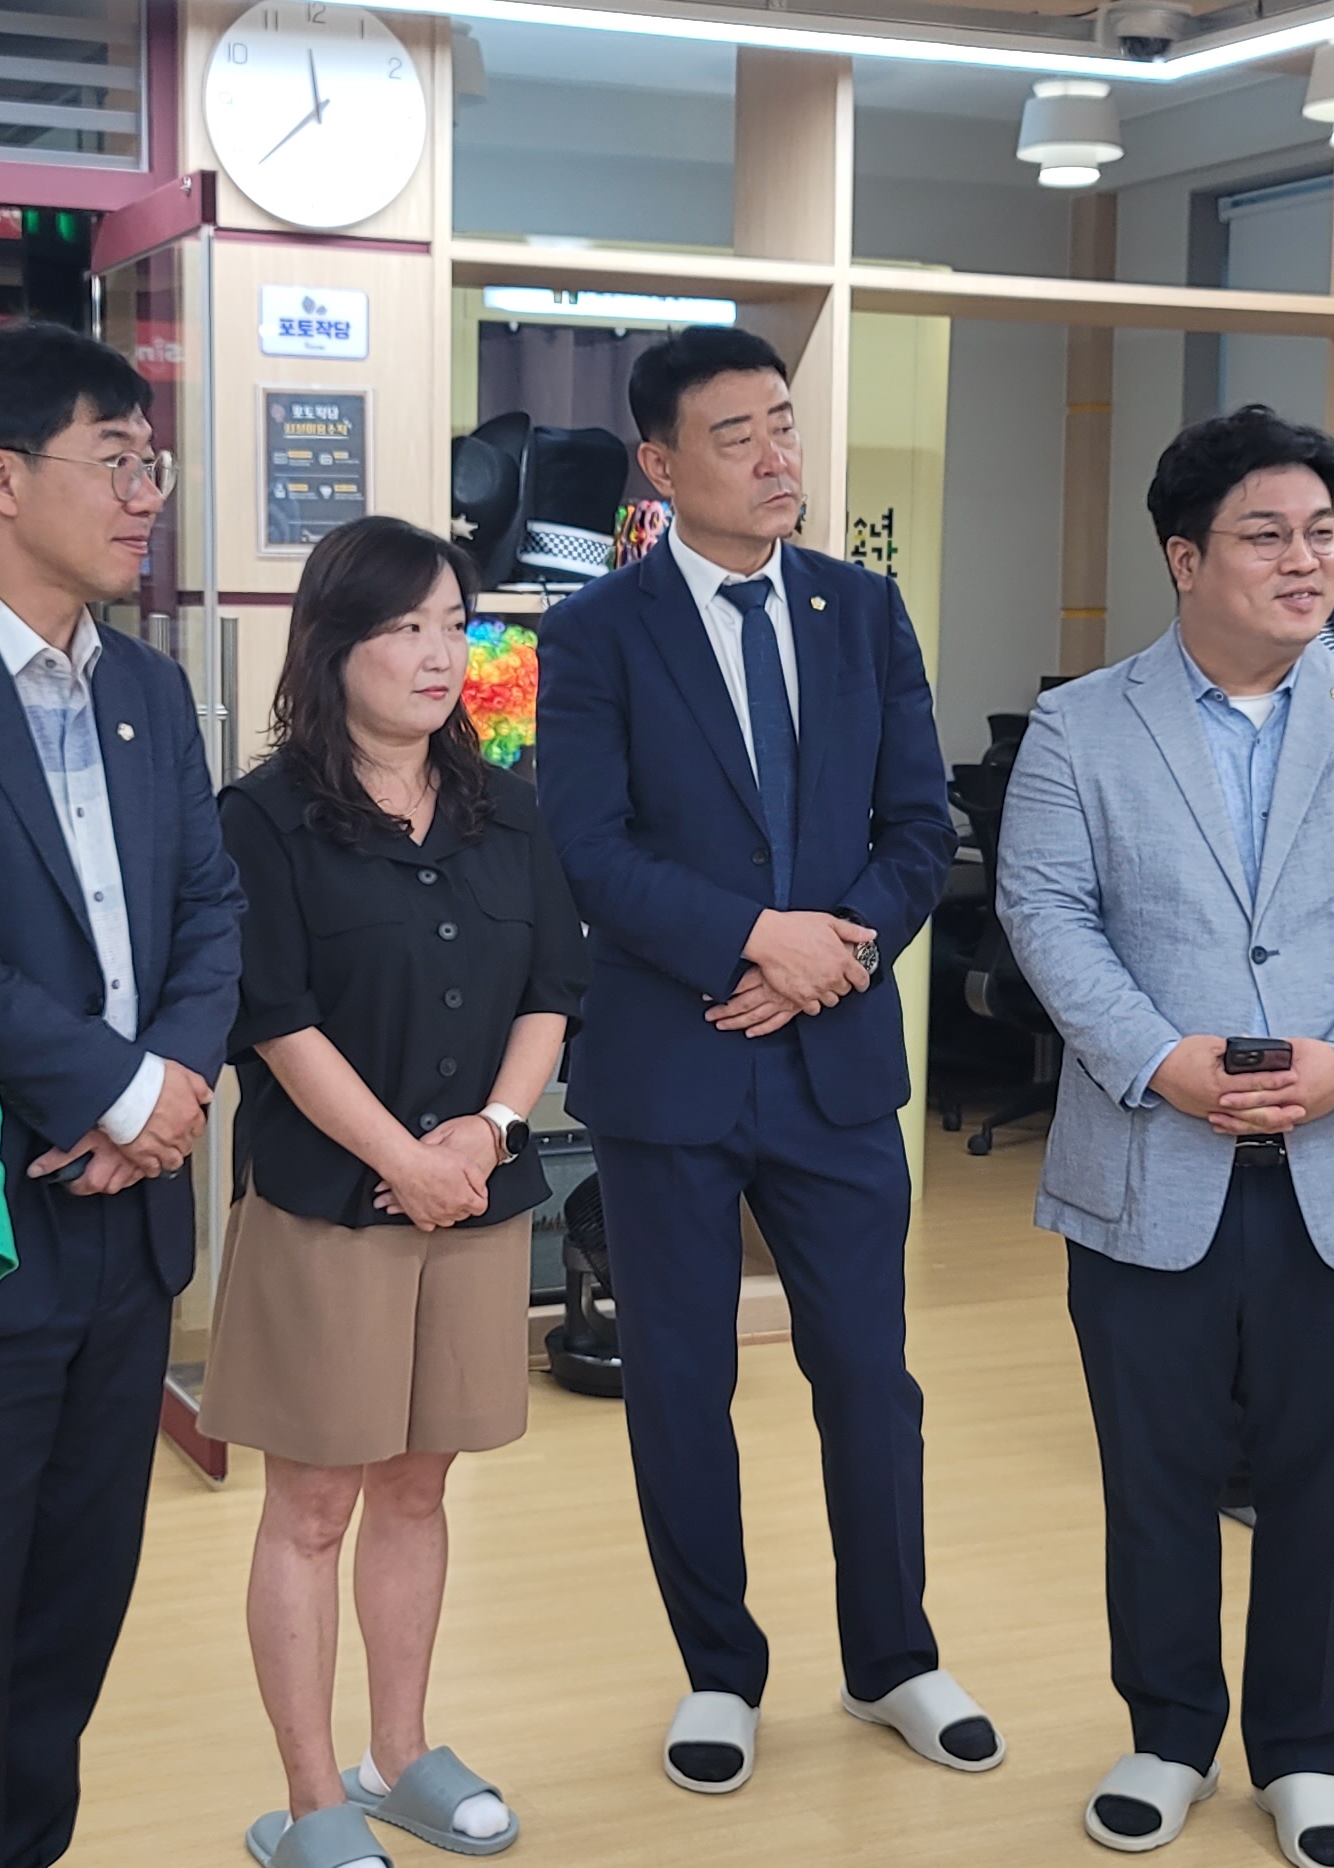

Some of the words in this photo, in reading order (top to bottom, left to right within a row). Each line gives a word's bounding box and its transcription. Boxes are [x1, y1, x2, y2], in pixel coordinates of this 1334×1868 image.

[264, 9, 279, 32] 11
[307, 3, 327, 24] 12
[227, 42, 249, 65] 10
[387, 56, 403, 80] 2
